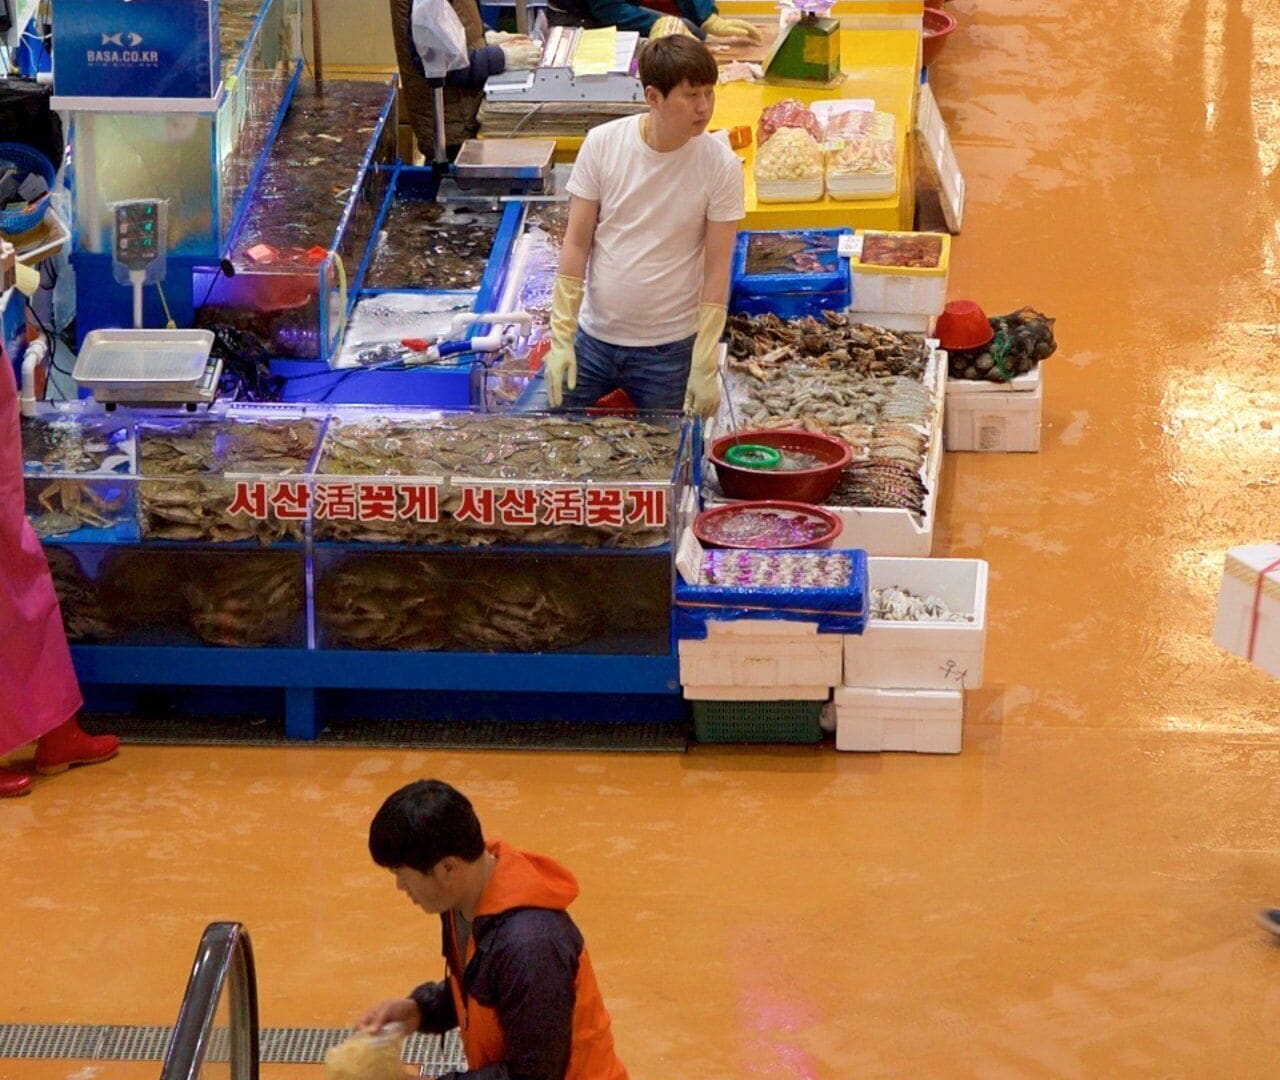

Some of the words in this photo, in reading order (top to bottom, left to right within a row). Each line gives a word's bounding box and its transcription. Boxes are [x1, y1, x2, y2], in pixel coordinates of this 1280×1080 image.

[86, 50, 159, 63] BASA.CO.KR
[226, 480, 440, 523] 서산活꽃게
[453, 486, 667, 528] 서산活꽃게
